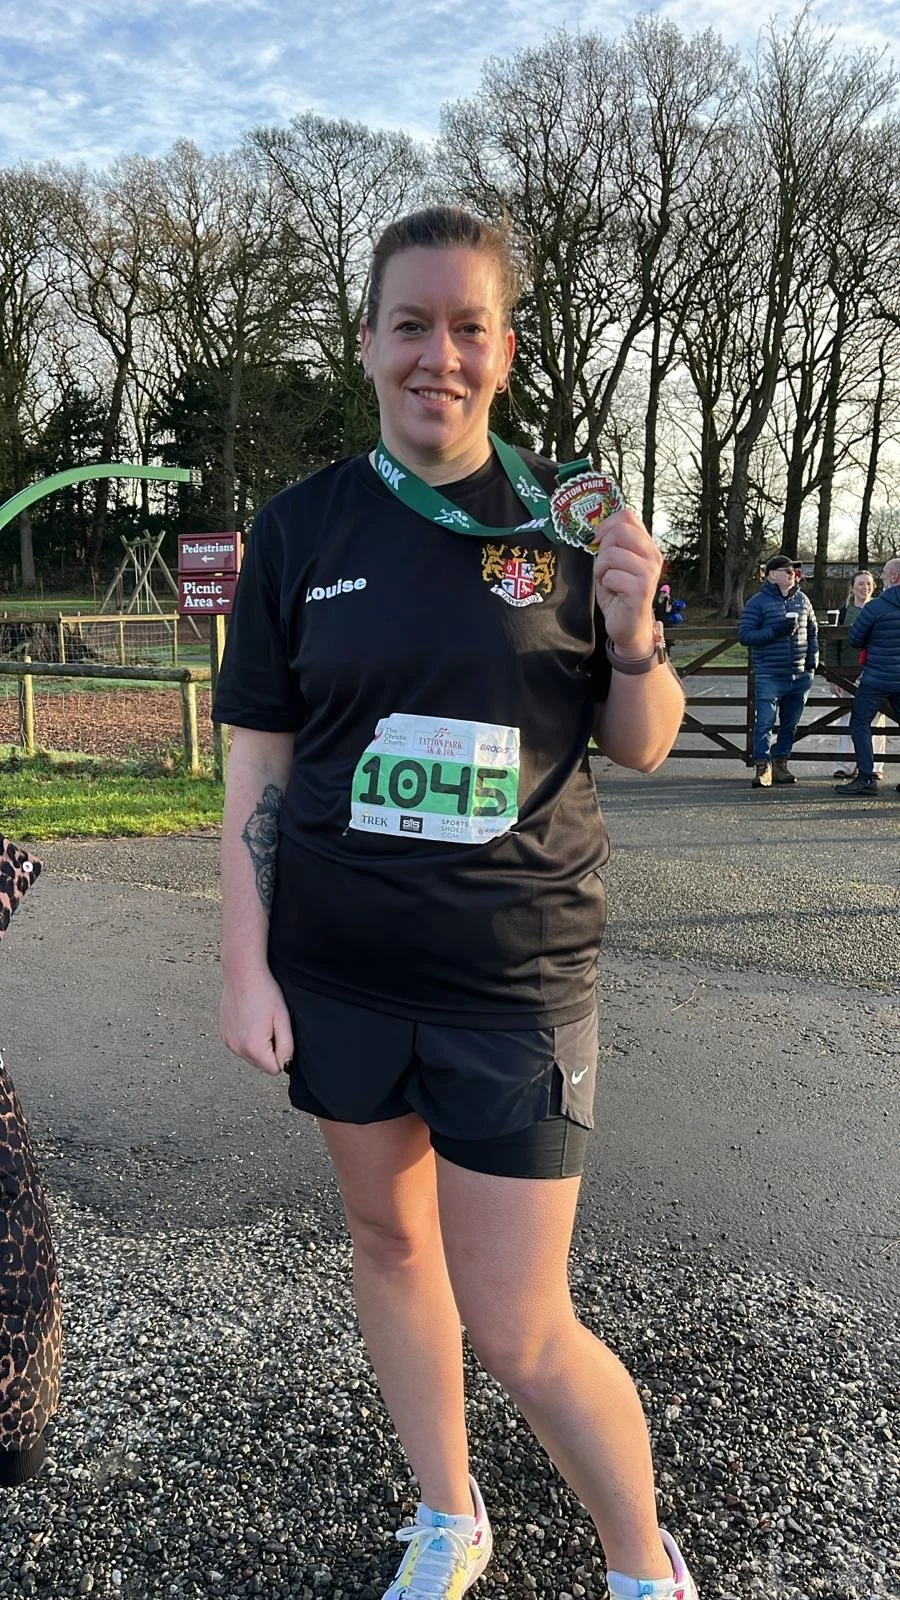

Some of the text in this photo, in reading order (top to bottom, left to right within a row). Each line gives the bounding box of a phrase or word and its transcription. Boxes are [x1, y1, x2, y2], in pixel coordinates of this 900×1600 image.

[378, 453, 407, 490] 10K
[556, 486, 582, 507] TATTON
[582, 479, 605, 491] PARK
[182, 543, 234, 554] Pedestrians
[183, 582, 222, 594] Picnic
[305, 577, 367, 603] Louise
[183, 596, 213, 607] Area
[358, 755, 508, 817] 1045
[361, 814, 388, 827] TREK
[440, 826, 464, 834] SHOES
